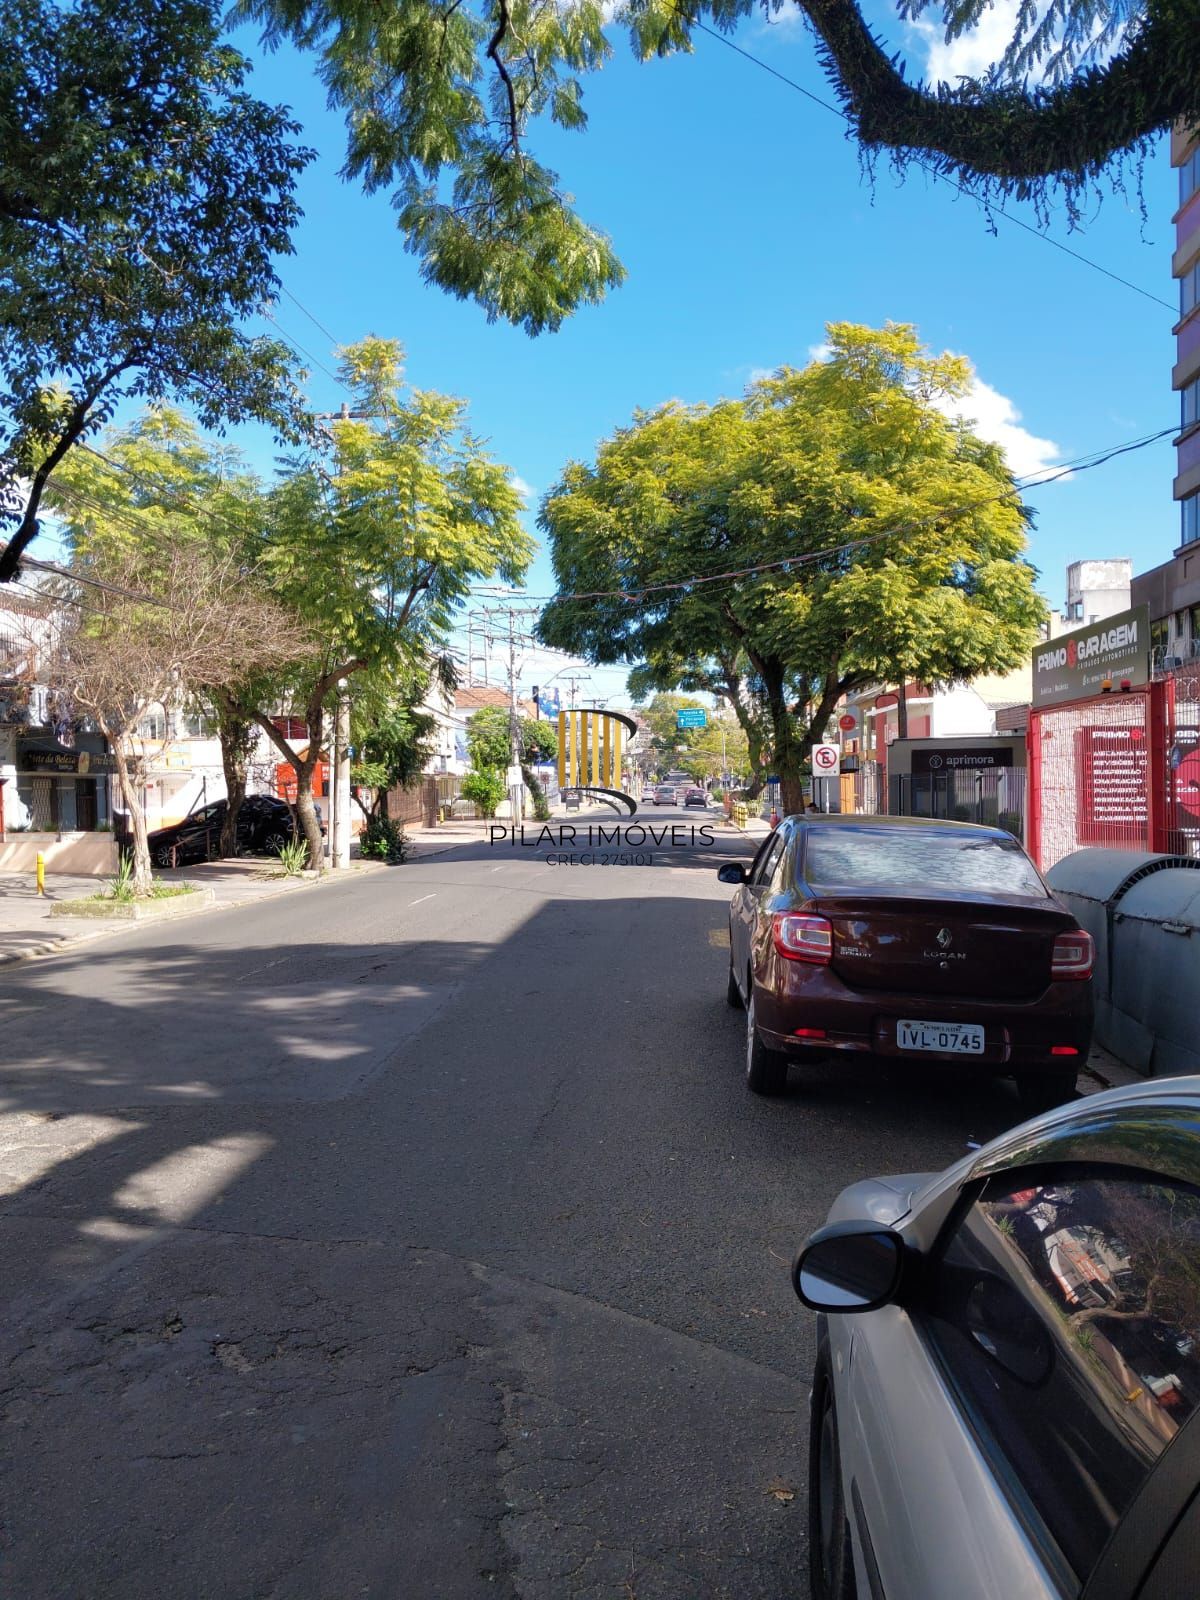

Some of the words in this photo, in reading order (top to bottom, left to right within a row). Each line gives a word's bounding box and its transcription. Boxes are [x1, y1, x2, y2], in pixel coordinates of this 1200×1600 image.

[1037, 648, 1067, 672] PRIMO
[1077, 621, 1138, 660] GARAGEM
[1092, 731, 1130, 739] PRIMO
[946, 754, 994, 767] aprimora
[923, 951, 967, 960] LOGAN
